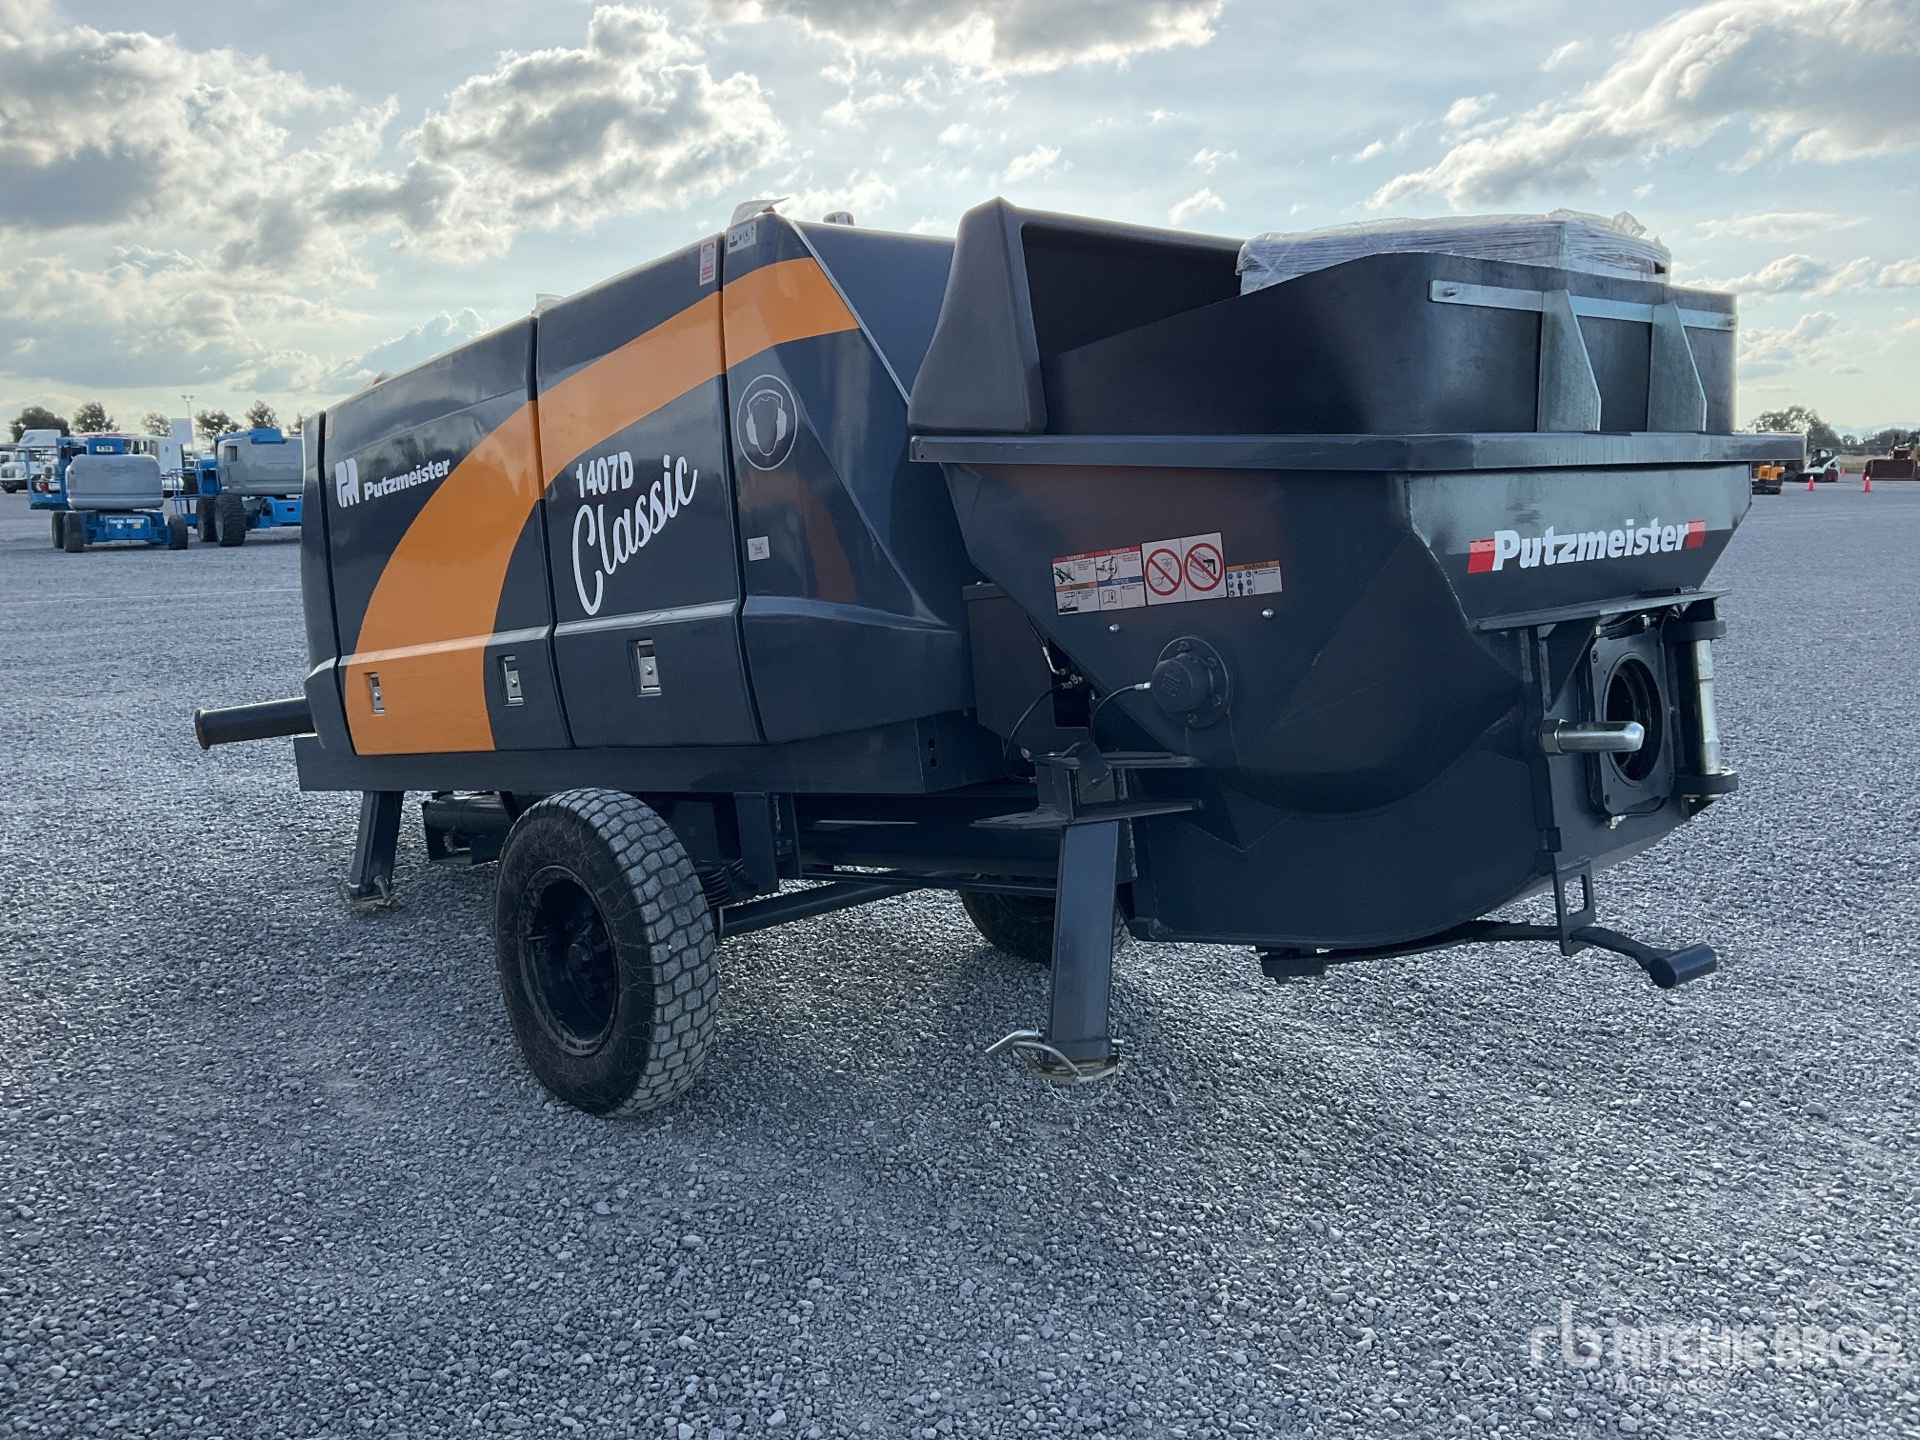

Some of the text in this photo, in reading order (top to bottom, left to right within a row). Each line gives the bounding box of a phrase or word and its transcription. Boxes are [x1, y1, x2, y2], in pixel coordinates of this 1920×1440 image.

[364, 459, 450, 501] Putzmeister
[576, 451, 634, 498] 1407D
[572, 454, 698, 616] Classic
[1492, 517, 1689, 571] Putzmeister
